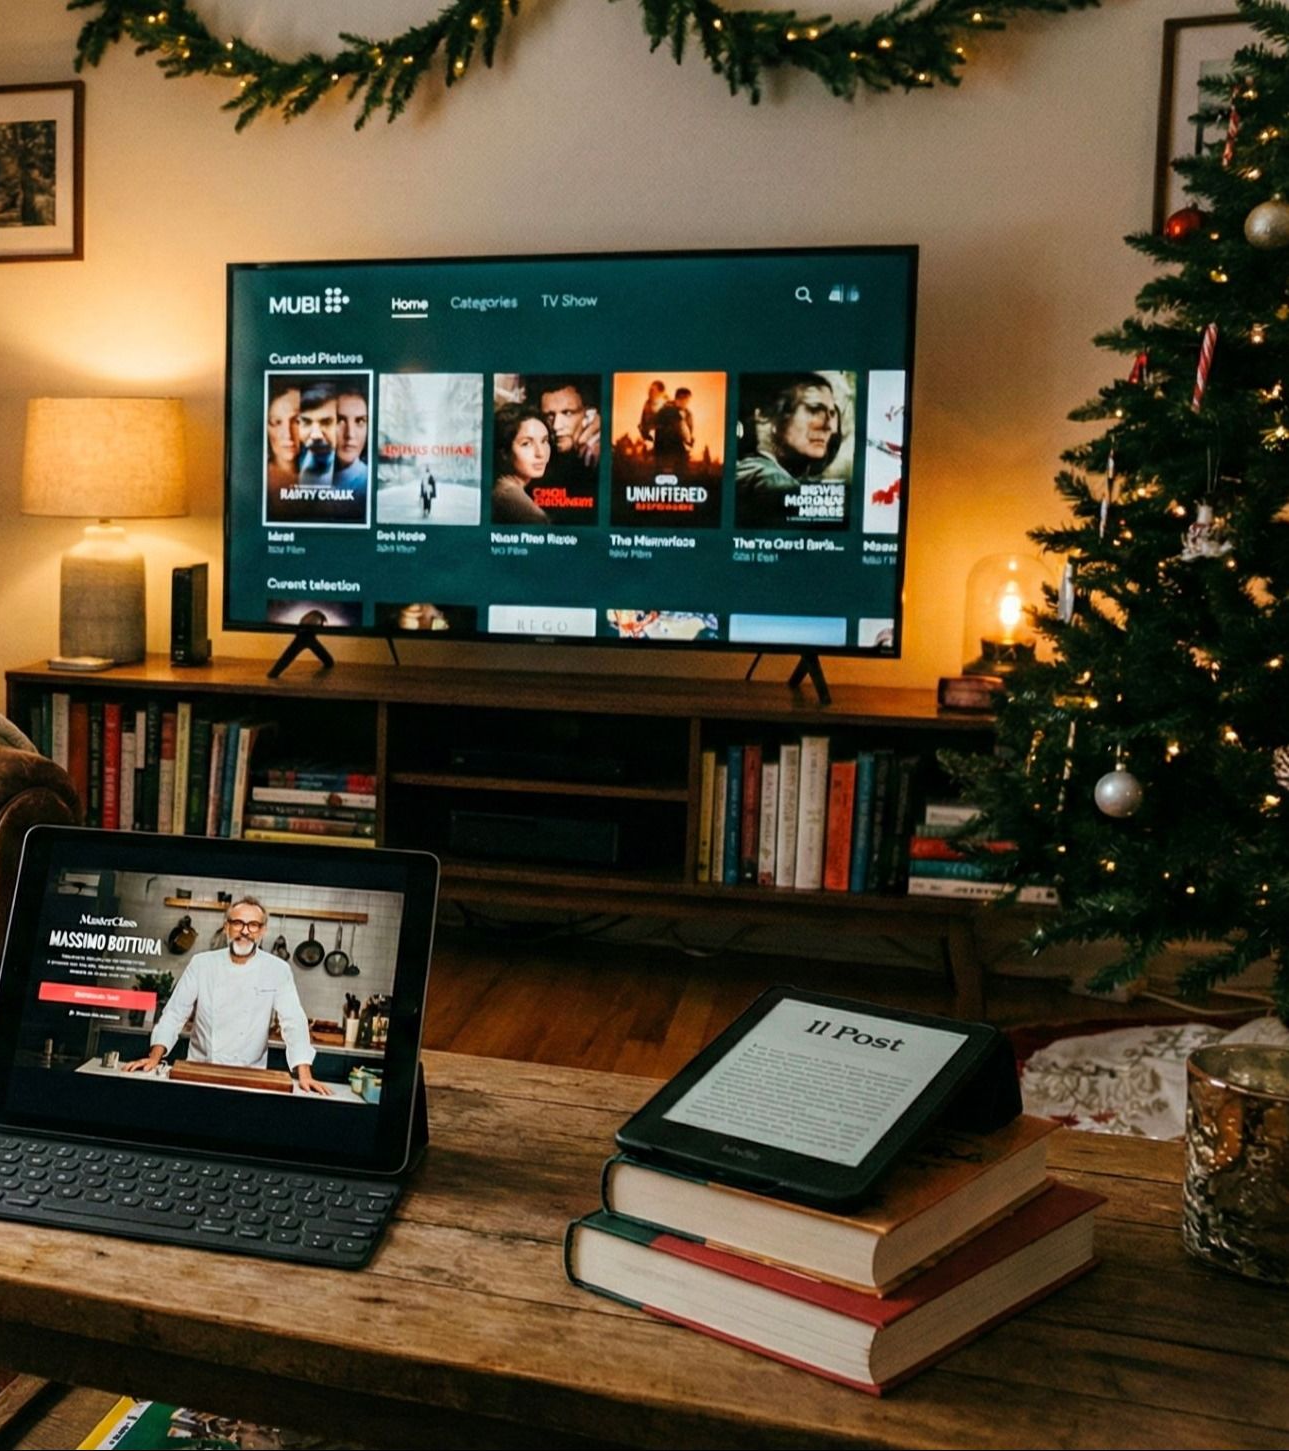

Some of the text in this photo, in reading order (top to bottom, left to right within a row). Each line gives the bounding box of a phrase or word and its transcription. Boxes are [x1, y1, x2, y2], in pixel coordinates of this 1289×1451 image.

[269, 296, 320, 314] MUBI
[391, 297, 429, 311] Home
[450, 296, 518, 312] Categories
[541, 294, 598, 307] TV Show
[49, 930, 162, 956] MASSIMO BOTTURA
[831, 1024, 906, 1053] Post
